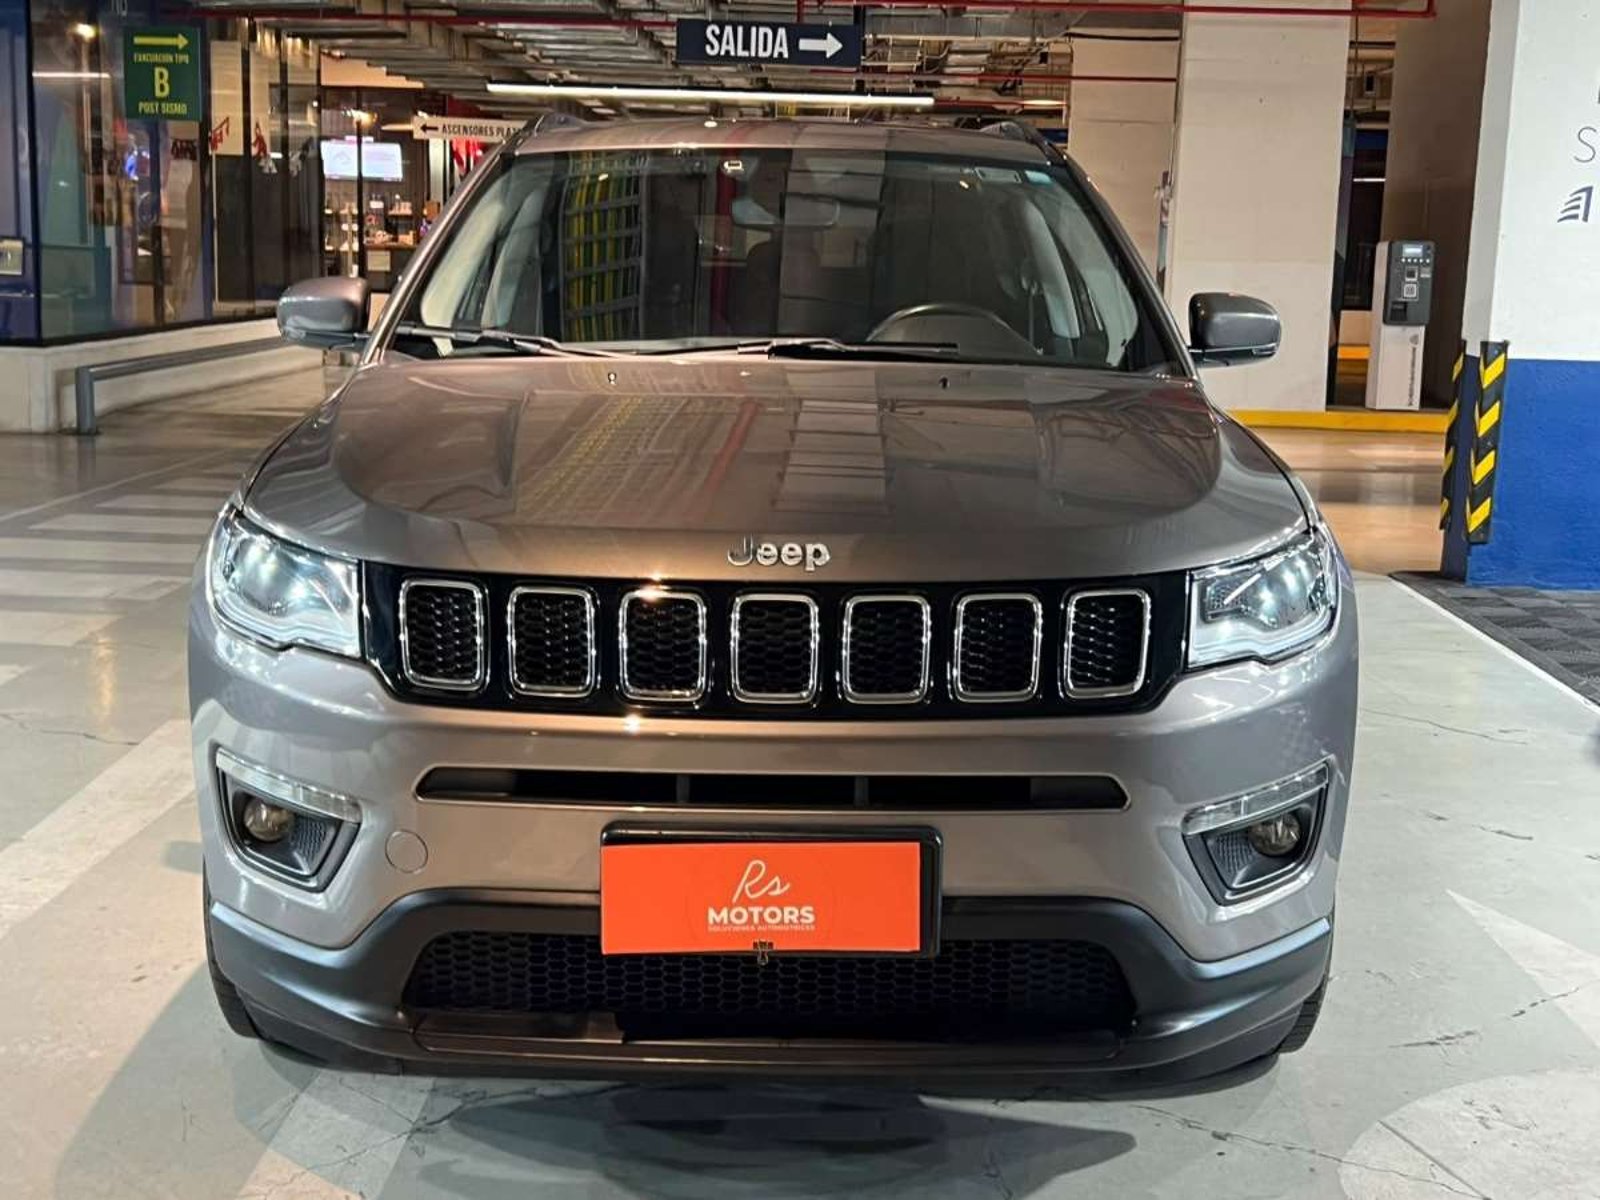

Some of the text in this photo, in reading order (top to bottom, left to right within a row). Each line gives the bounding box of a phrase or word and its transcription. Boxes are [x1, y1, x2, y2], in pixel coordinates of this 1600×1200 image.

[705, 24, 789, 58] SALIDA
[154, 66, 170, 98] B
[138, 101, 188, 115] POST SISMO
[442, 124, 494, 136] ASCENSORES
[727, 535, 831, 571] Jeep
[707, 906, 816, 925] MOTORS
